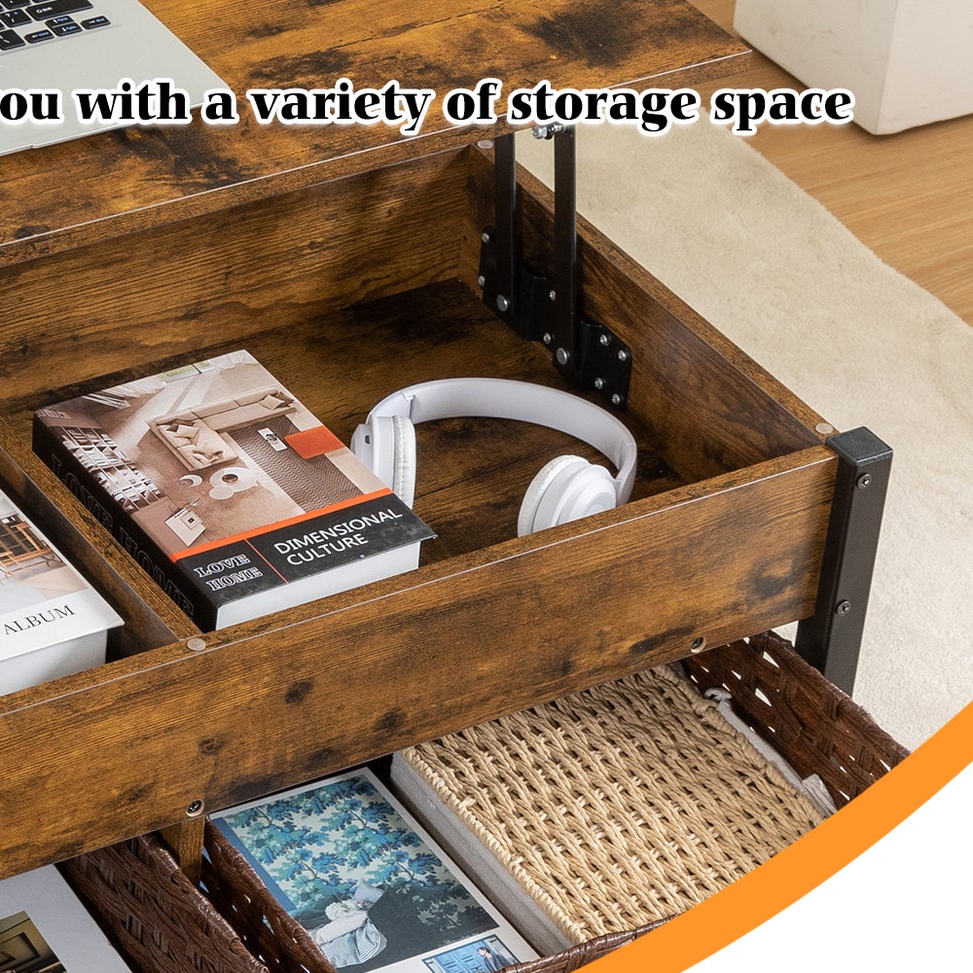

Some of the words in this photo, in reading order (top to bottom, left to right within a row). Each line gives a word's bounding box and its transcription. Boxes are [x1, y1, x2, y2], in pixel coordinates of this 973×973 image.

[273, 508, 404, 555] DIMENSIONAL
[193, 553, 250, 579] LOVE
[285, 533, 369, 567] CULTURE
[206, 566, 263, 592] HOME
[3, 603, 77, 636] ALBUM
